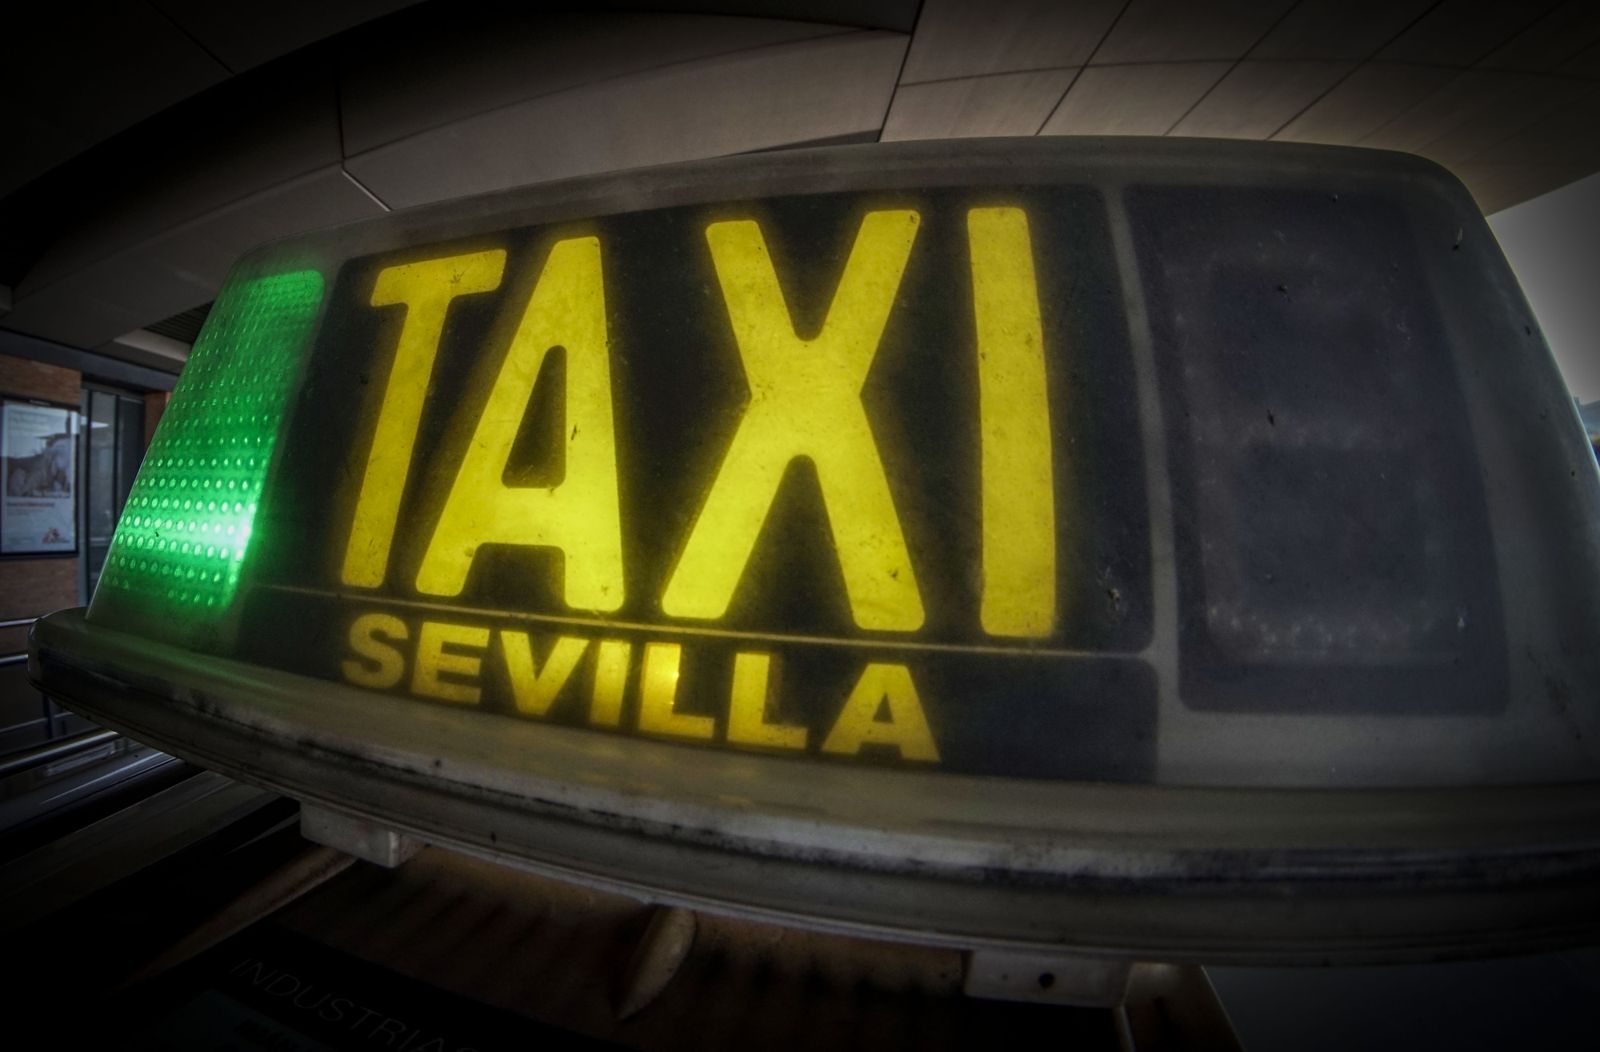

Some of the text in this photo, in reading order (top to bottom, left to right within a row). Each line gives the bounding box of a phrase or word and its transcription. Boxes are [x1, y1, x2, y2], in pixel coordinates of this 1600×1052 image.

[341, 207, 1056, 638] TAXI
[341, 614, 940, 762] SEVILLA
[229, 957, 480, 1052] INDUSTRIA
